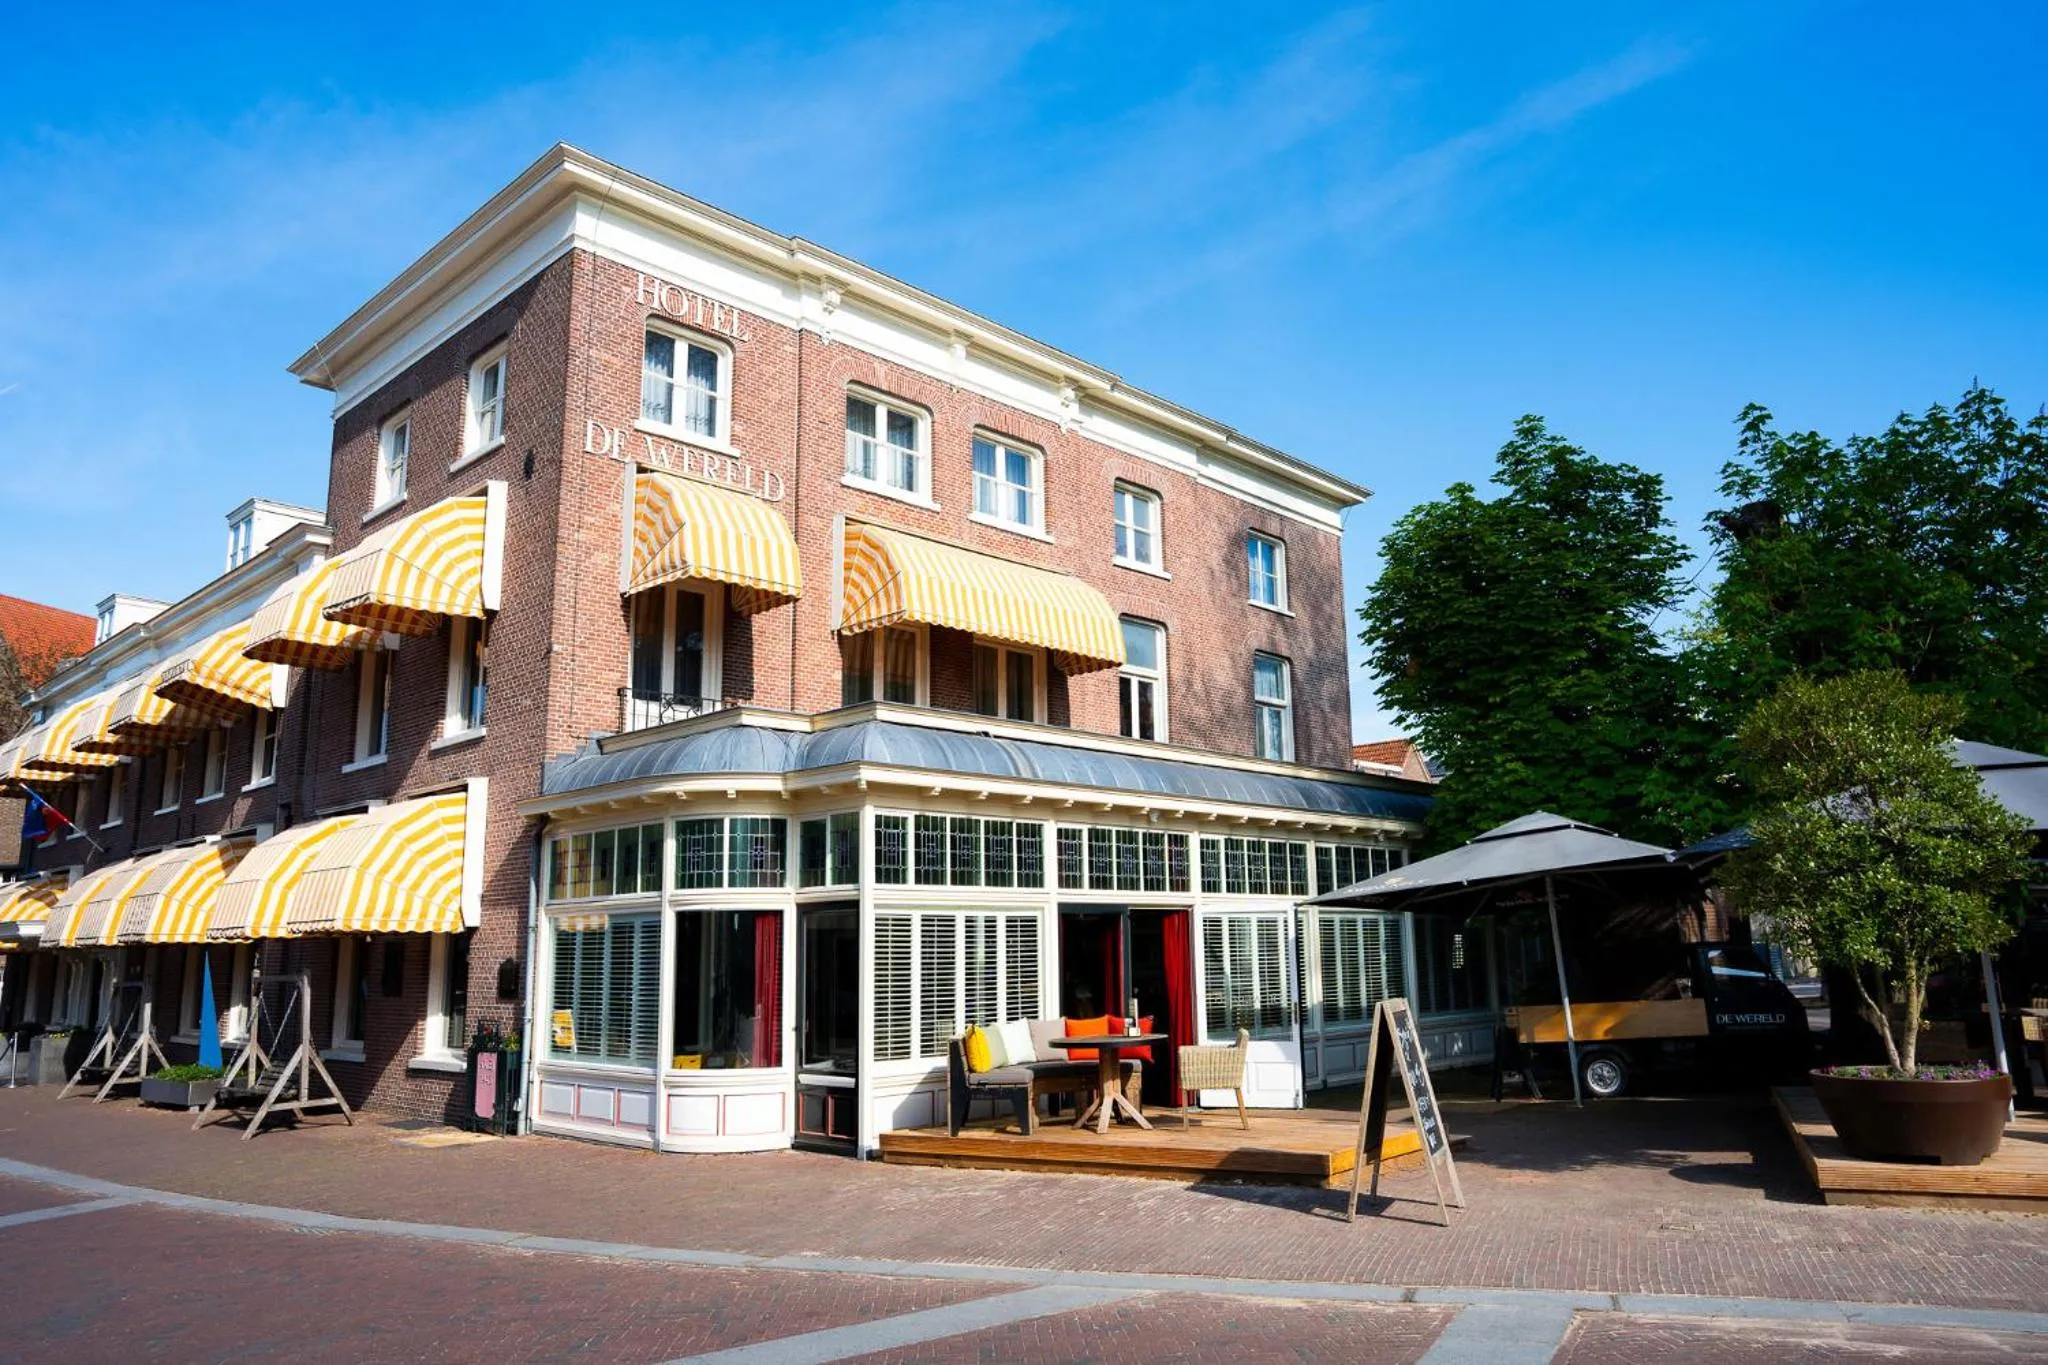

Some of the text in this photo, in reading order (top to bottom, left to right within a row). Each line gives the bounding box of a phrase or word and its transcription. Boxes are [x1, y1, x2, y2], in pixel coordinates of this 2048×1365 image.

[635, 273, 749, 342] HOTEL
[584, 418, 785, 502] DE WERELD
[1716, 1013, 1785, 1024] DE WERELD
